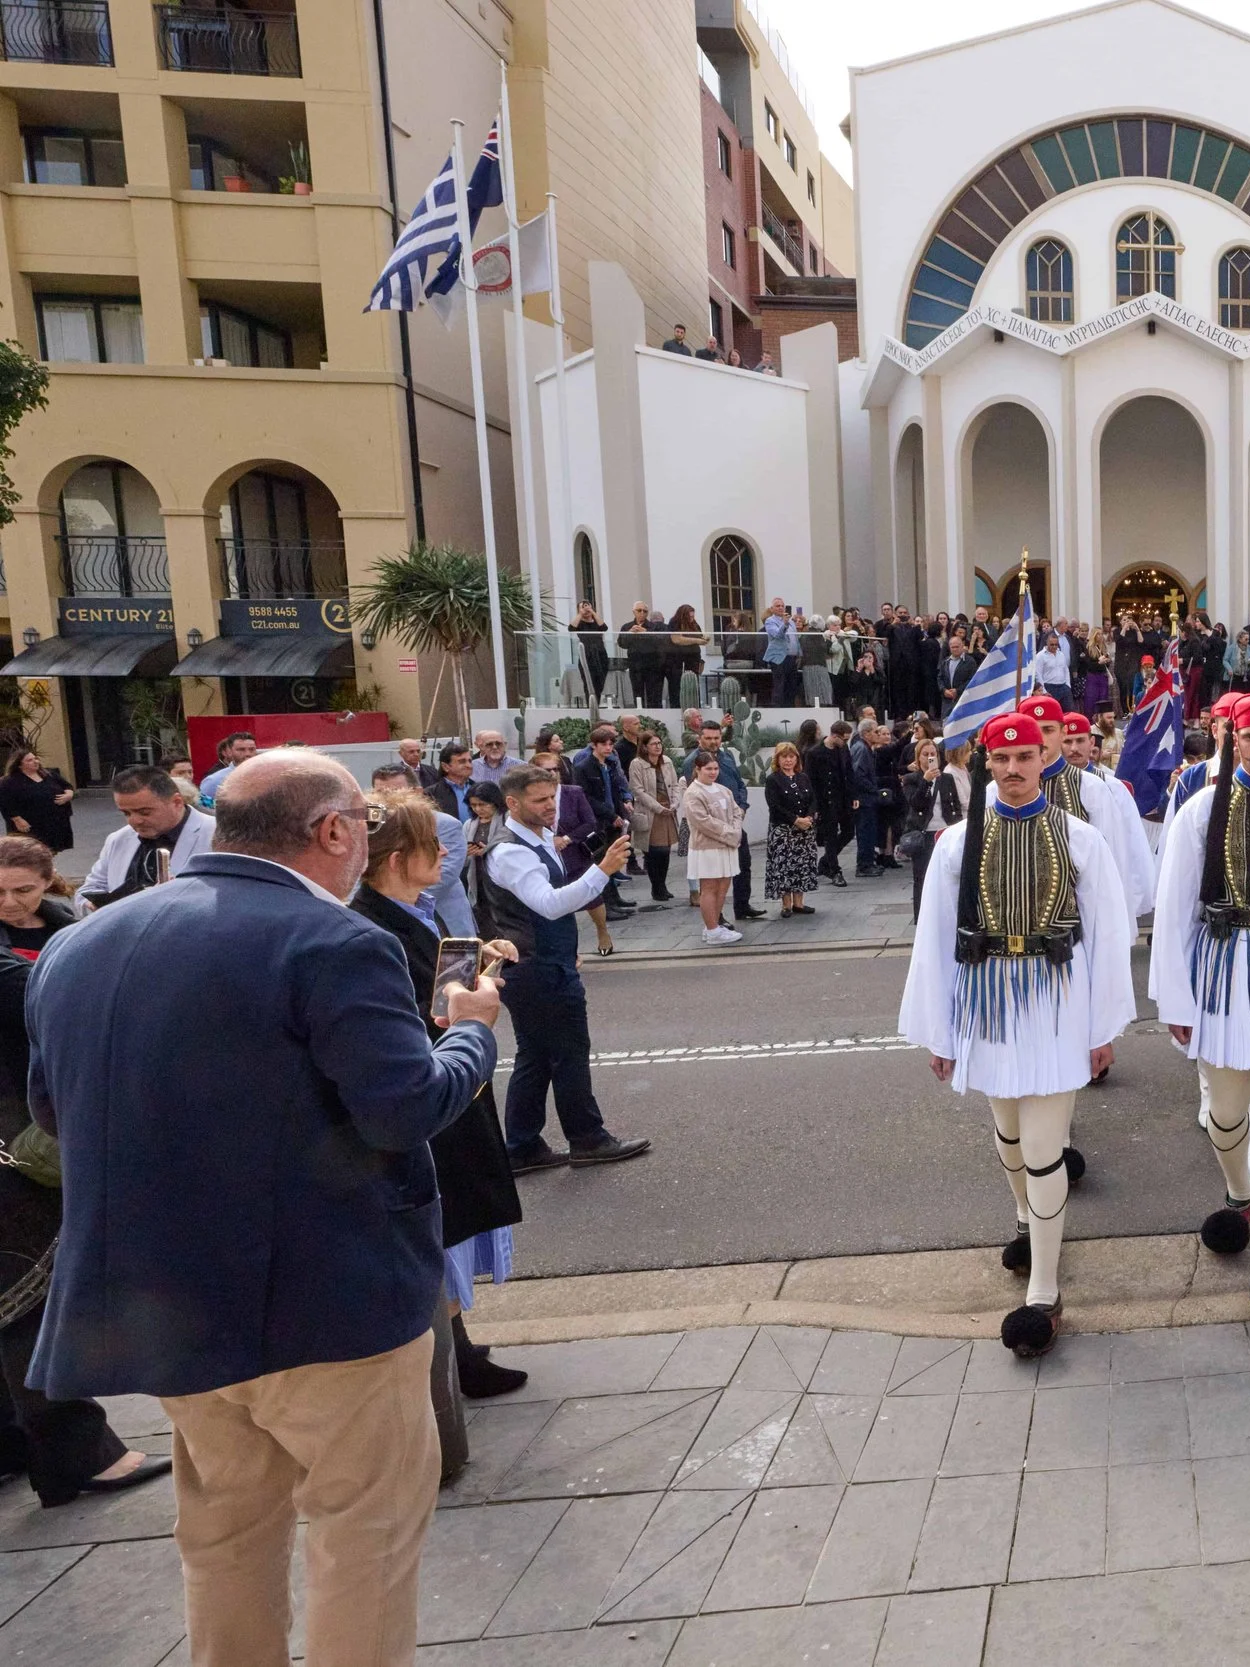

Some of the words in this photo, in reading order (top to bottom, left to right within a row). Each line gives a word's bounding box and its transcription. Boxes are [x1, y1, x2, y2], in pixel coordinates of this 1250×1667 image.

[65, 609, 152, 622] CENTURY
[157, 609, 173, 623] 21
[248, 606, 272, 617] 9588
[274, 606, 298, 617] 4455
